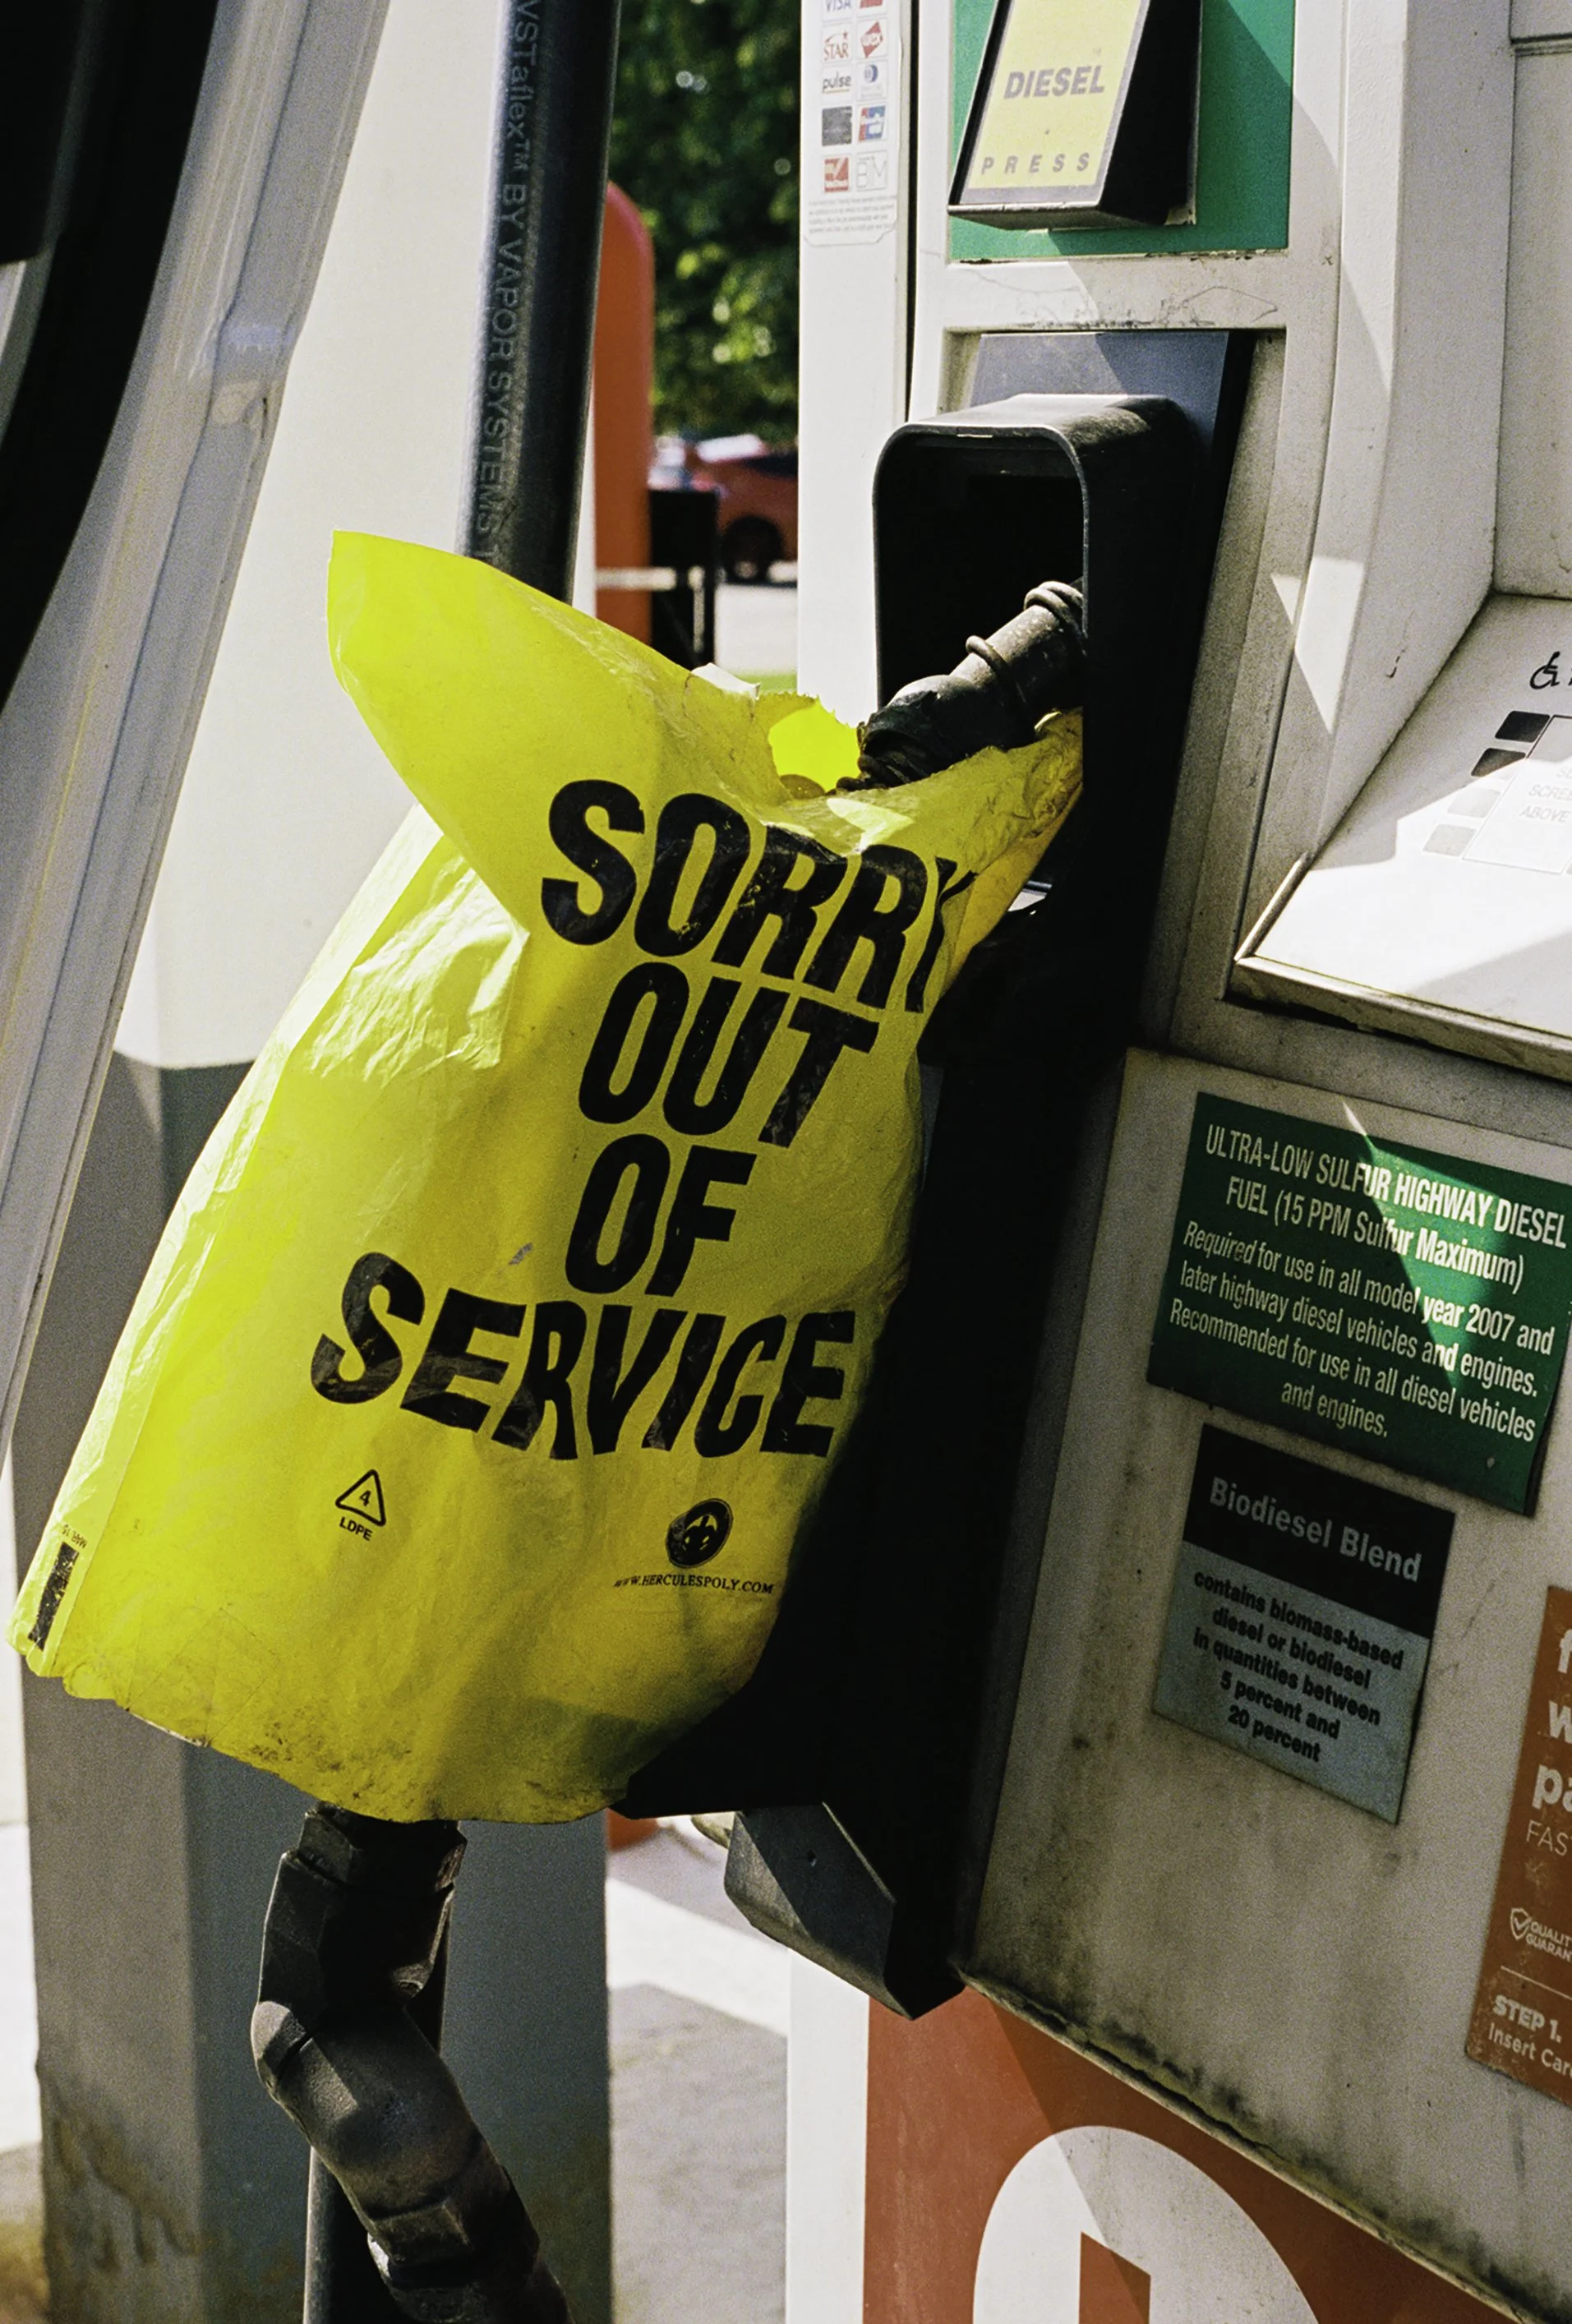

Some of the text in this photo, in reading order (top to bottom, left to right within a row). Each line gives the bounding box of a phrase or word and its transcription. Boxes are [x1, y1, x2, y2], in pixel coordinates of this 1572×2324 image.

[823, 71, 851, 93] pulse
[824, 43, 848, 61] STAR
[1003, 65, 1105, 99] DIESEL
[499, 183, 526, 229] BY
[981, 152, 1090, 175] PRESS
[489, 238, 524, 361] VAPOR
[476, 371, 512, 533] SYSTEMS
[1519, 805, 1571, 823] ABOVE
[541, 779, 978, 1013] SORRY
[579, 961, 880, 1149] OUT
[565, 1133, 758, 1297] OF
[1206, 1123, 1566, 1249] ULTRA-LOW SULFUR HIGHWAY DIESEL
[1226, 1176, 1524, 1295] FUEL (15 PPM Sulfur Maximum)
[1180, 1260, 1537, 1398] later highway diesel vehicles and engines.
[1183, 1220, 1556, 1356] Required for use in all model year 2007 and
[310, 1252, 855, 1460] SERVICE
[1169, 1298, 1536, 1442] Recommended for use in all diesel vehicles
[1281, 1382, 1387, 1437] and engines.
[339, 1516, 373, 1542] LDPE
[359, 1490, 371, 1507] 4
[1210, 1476, 1422, 1583] Biodiesel Blend
[1194, 1570, 1404, 1671] contains biomass-based
[1212, 1607, 1371, 1690] diesel or biodiesel
[1193, 1626, 1381, 1726] in quantities between
[1220, 1670, 1341, 1740] 5 percent and
[1228, 1704, 1321, 1762] 20 percent
[1488, 2022, 1572, 2079] Insert Car
[1492, 1994, 1562, 2043] STEP 1.
